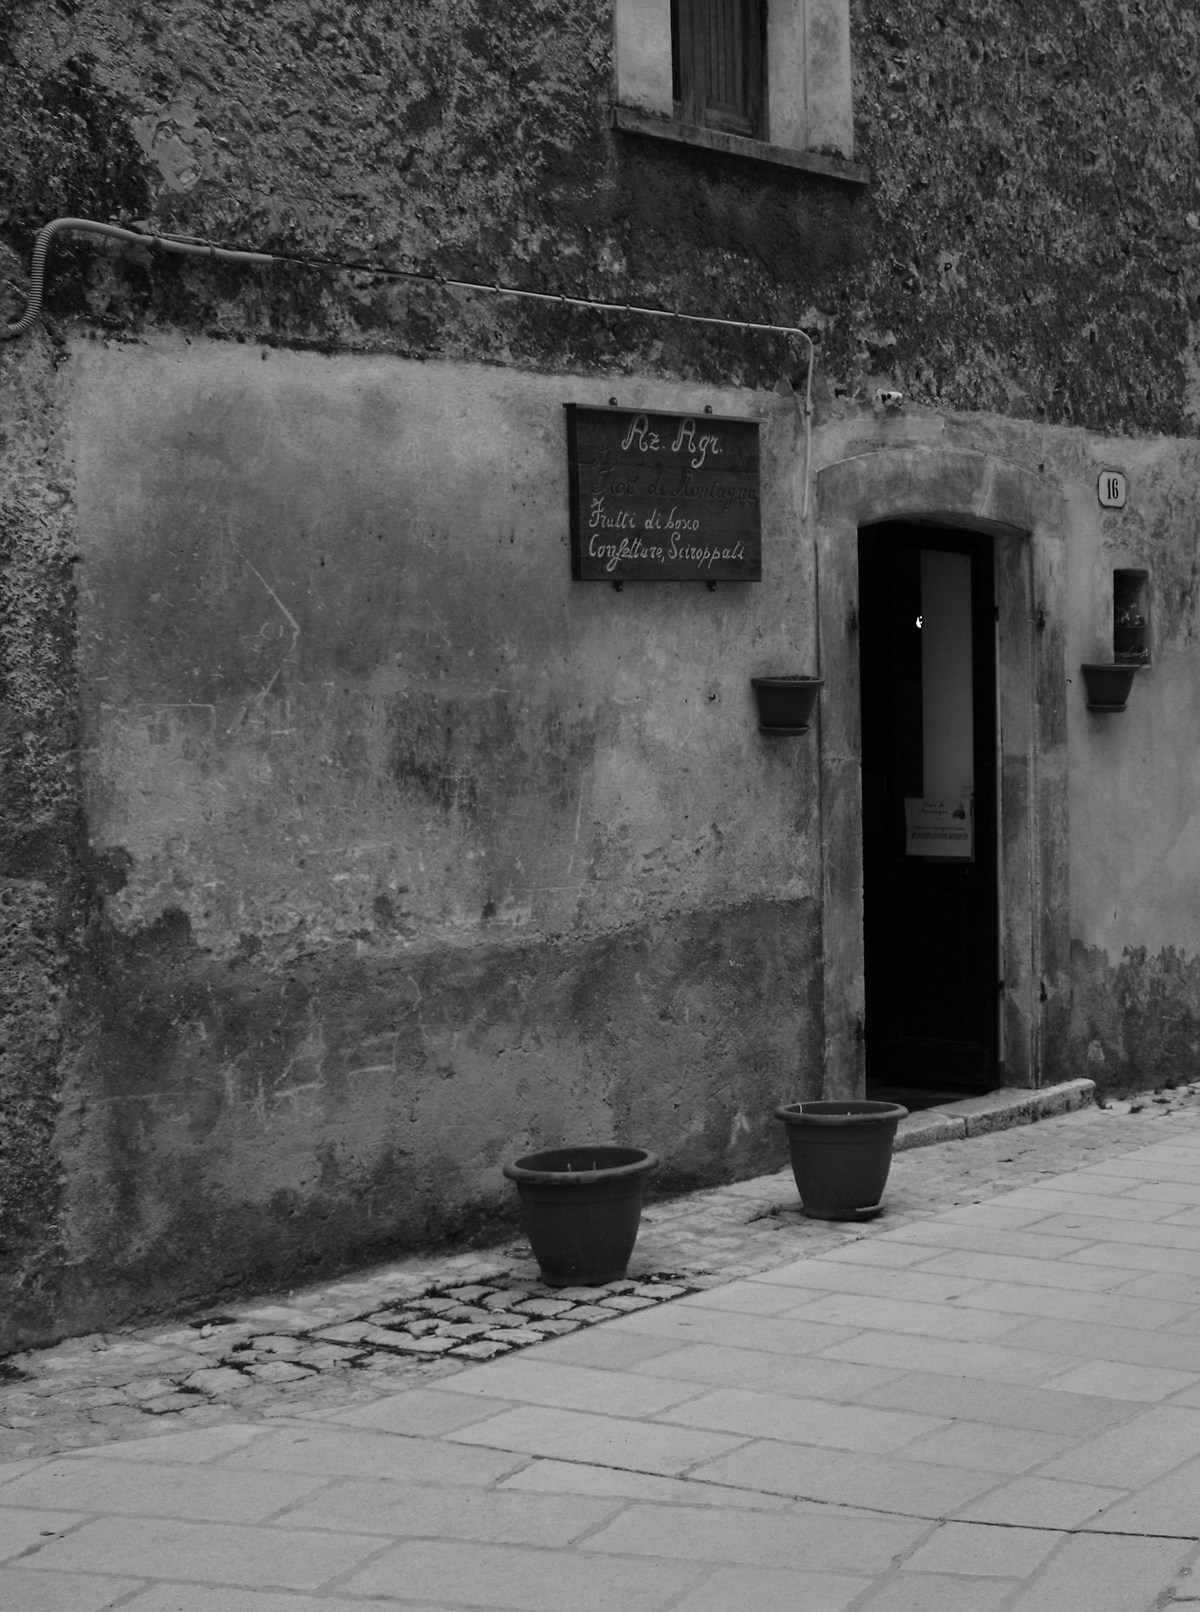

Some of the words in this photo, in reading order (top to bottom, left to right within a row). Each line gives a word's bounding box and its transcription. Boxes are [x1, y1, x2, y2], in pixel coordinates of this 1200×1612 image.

[621, 412, 666, 451] Az.
[671, 416, 723, 468] Agr.
[1107, 478, 1119, 499] 16
[588, 497, 636, 529] Frutti
[644, 507, 661, 530] di
[664, 505, 700, 531] bosco
[588, 533, 665, 572] Confetture,
[667, 531, 745, 569] Sciroppati
